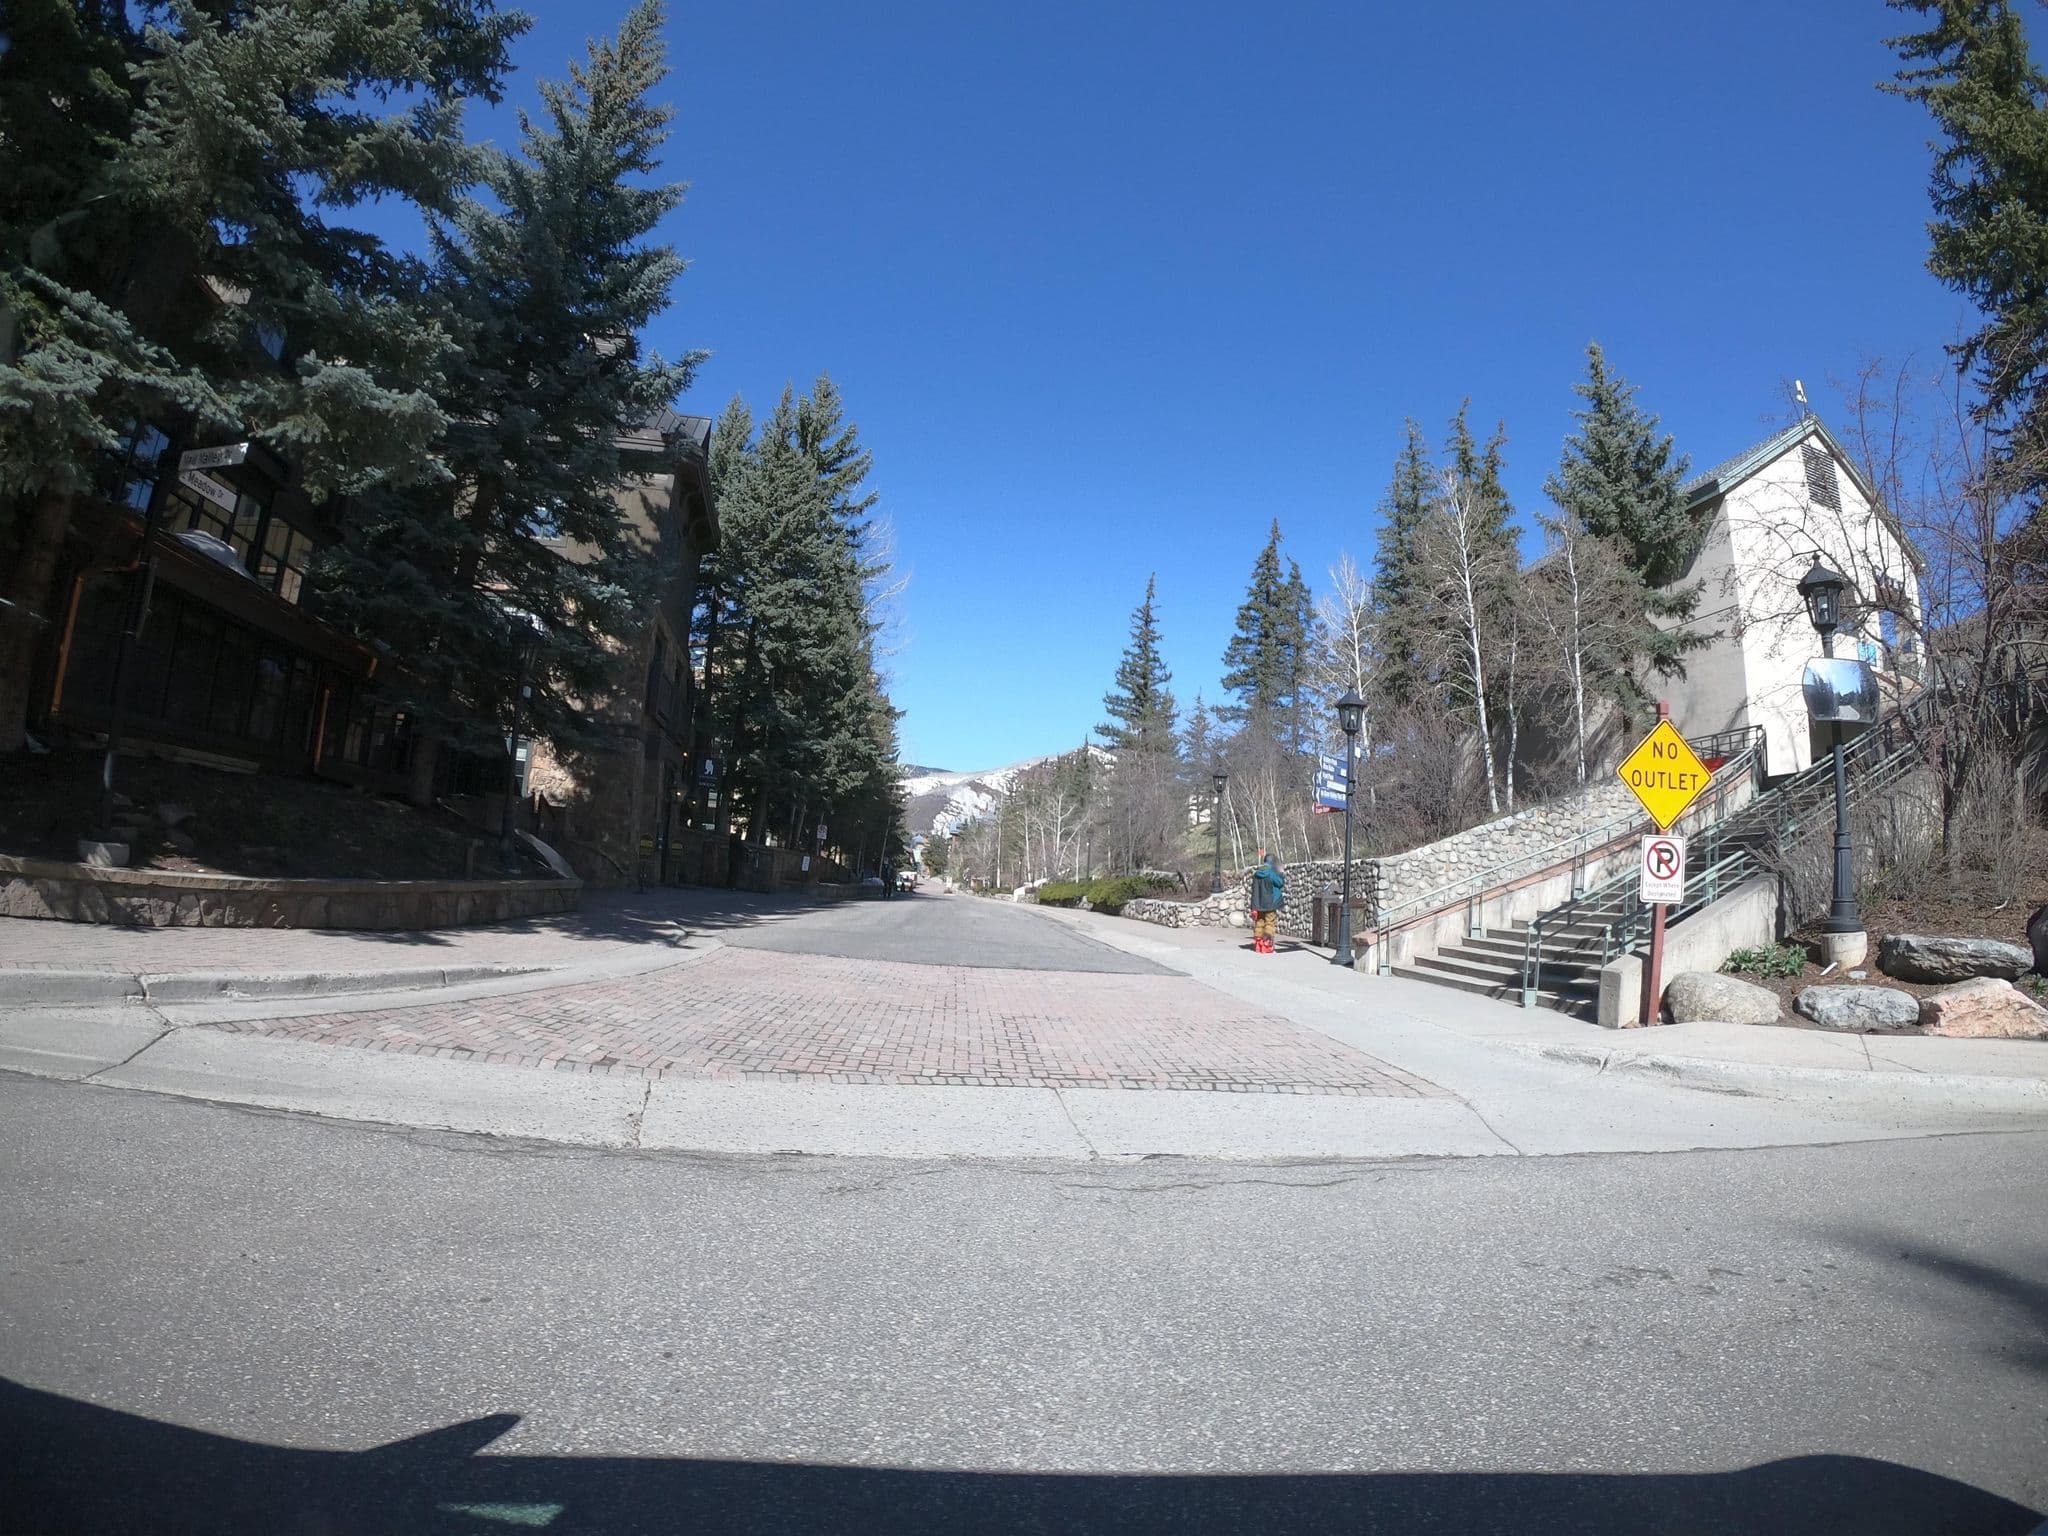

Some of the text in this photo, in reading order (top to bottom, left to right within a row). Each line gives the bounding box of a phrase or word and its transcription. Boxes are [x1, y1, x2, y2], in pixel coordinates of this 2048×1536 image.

[187, 471, 216, 496] Meadow
[1653, 742, 1678, 760] NO
[1631, 770, 1699, 791] OUTLET
